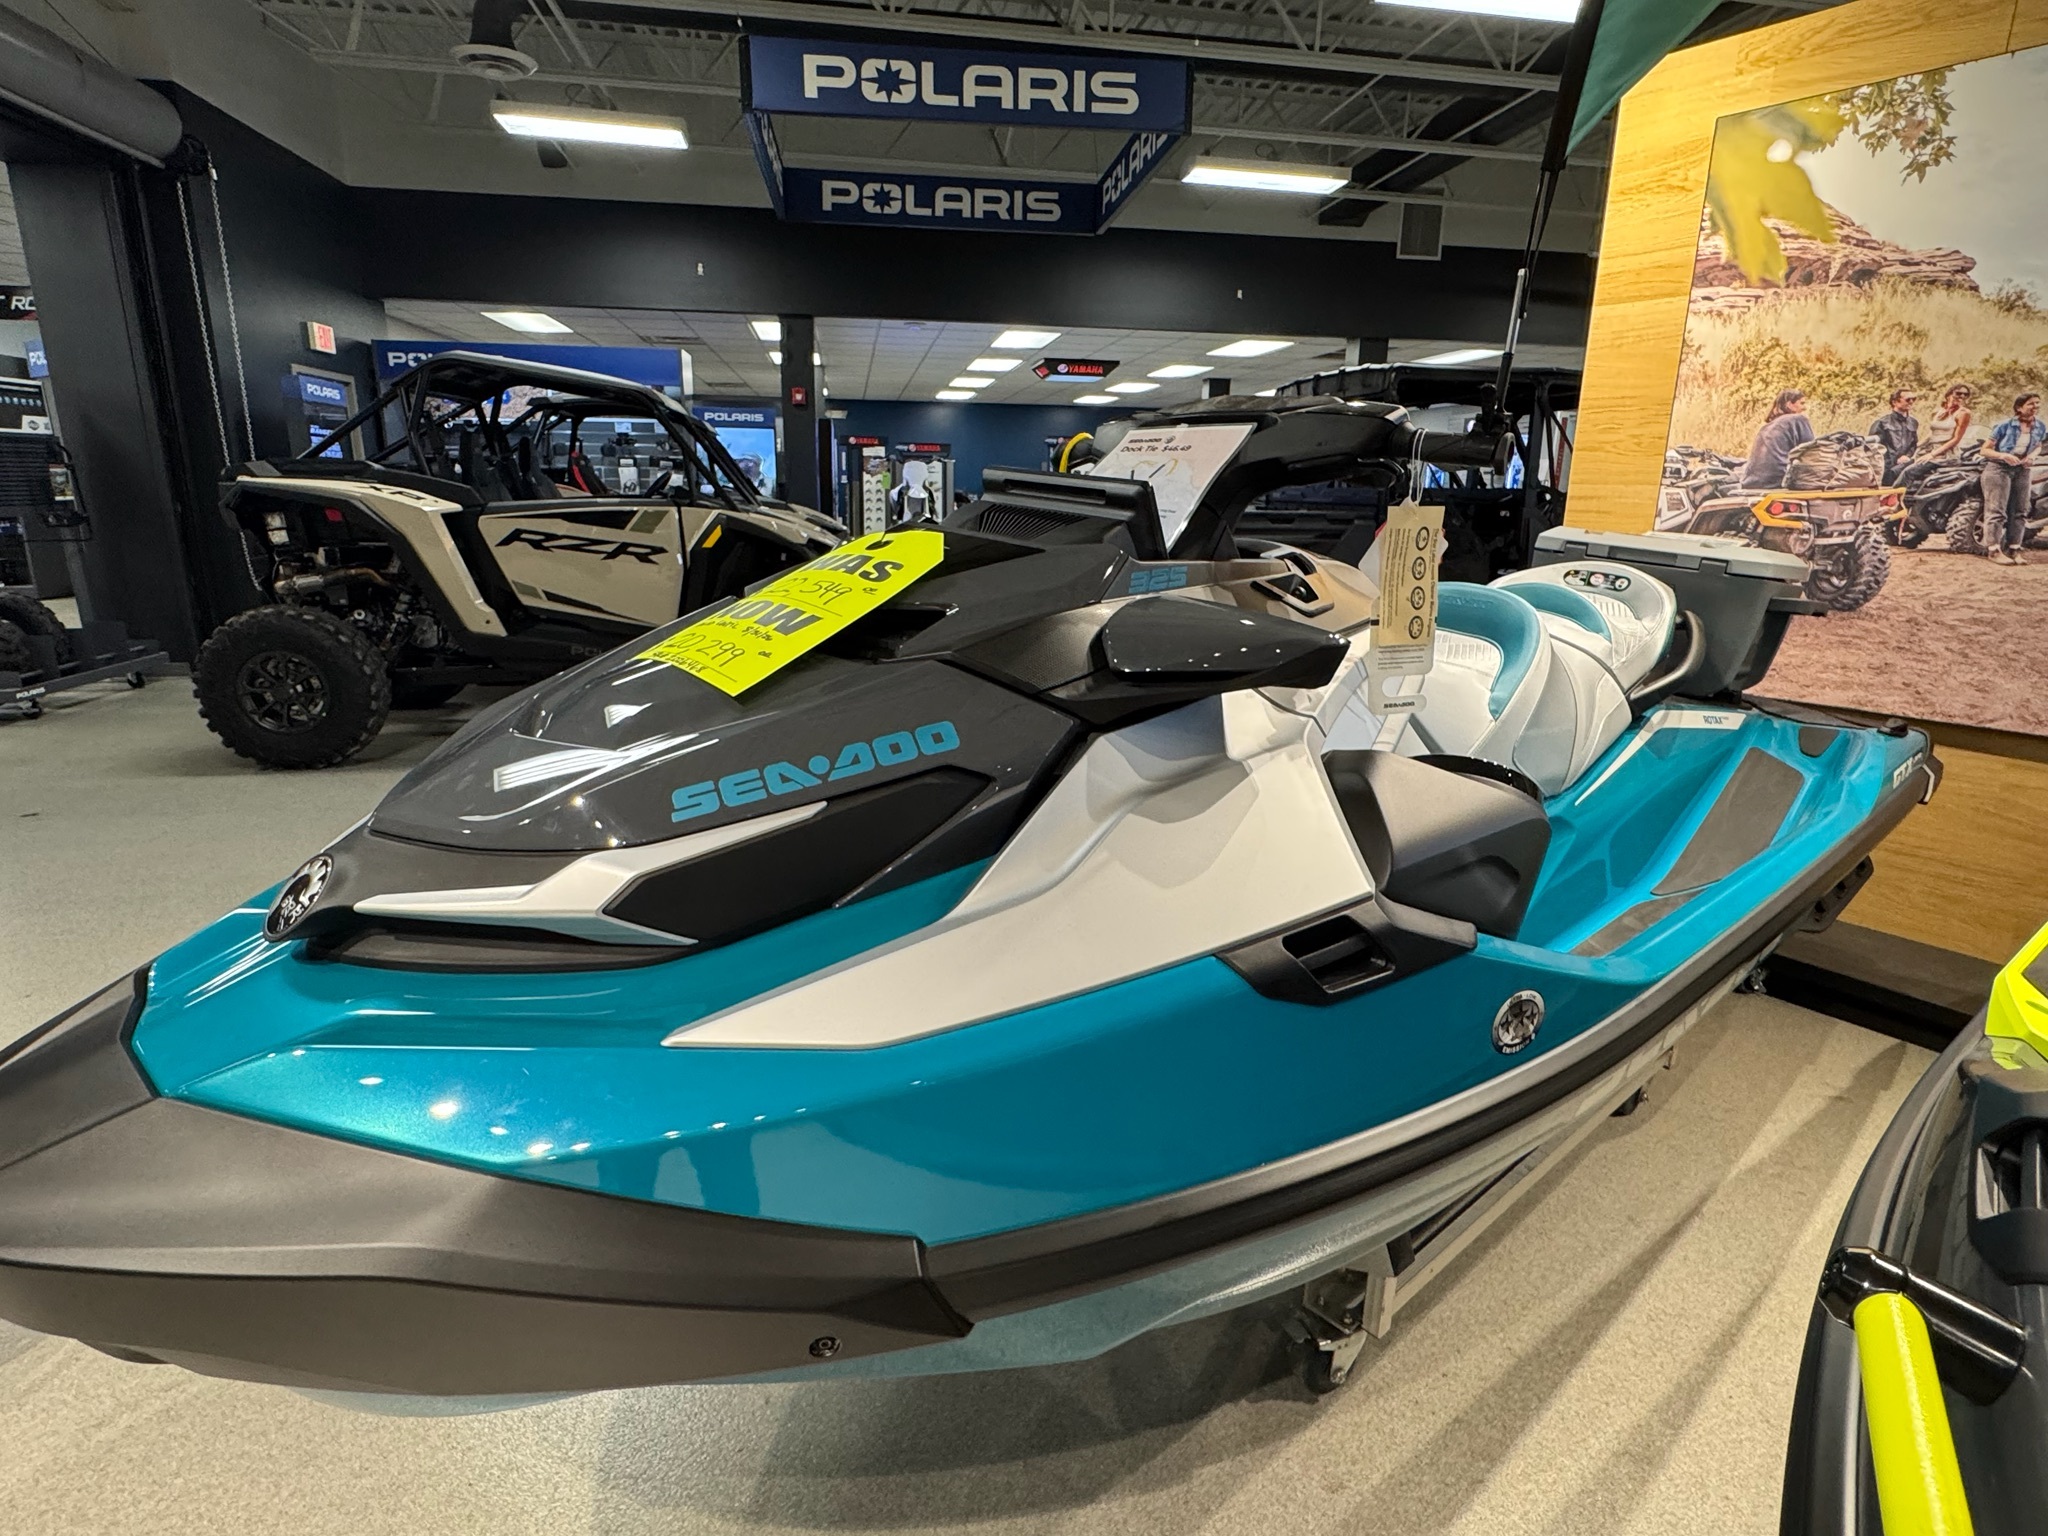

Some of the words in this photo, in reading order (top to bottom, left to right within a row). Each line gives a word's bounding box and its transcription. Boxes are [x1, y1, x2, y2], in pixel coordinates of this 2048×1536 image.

[802, 53, 1140, 115] POLARIS
[821, 179, 1062, 222] POLARIS
[1069, 365, 1104, 374] YAMAHA
[306, 383, 341, 401] POLARIS
[704, 412, 765, 422] POLARIS
[494, 528, 669, 566] RZR
[800, 553, 905, 582] WAS
[1128, 565, 1188, 595] 325
[16, 687, 46, 699] POLARIS
